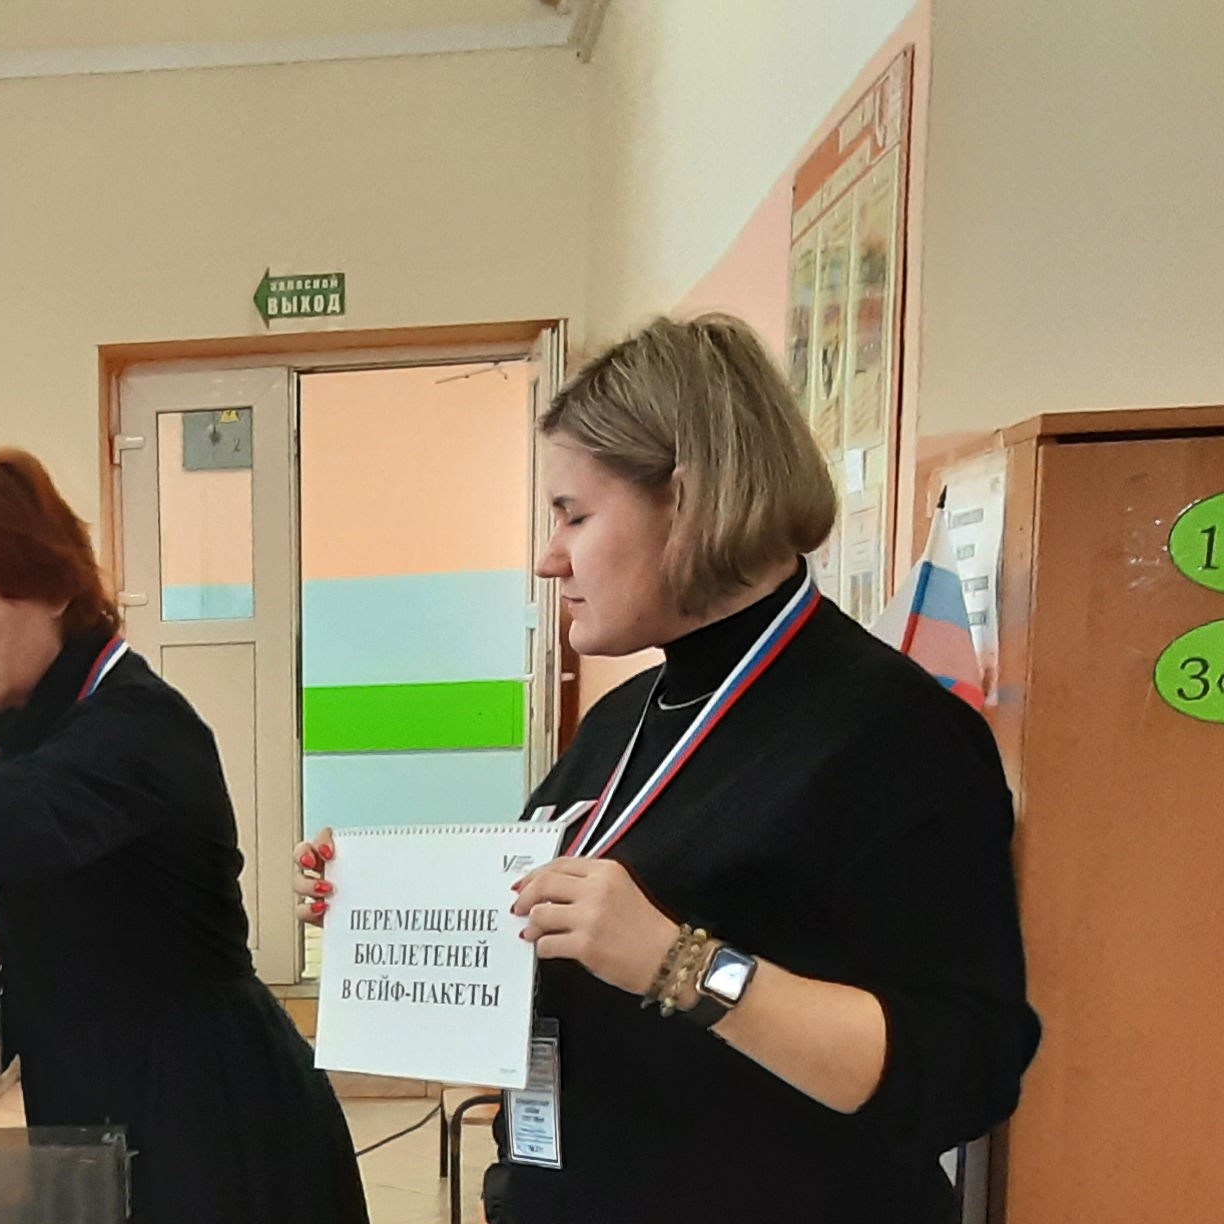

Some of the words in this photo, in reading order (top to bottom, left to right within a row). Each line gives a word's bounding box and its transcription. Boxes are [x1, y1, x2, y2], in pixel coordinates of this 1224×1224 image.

[266, 292, 341, 315] ВЫХОД
[349, 908, 499, 933] ПЕРЕМЕЩЕНИЕ
[354, 940, 490, 968] БЮЛЛЕТЕНЕЙ
[341, 978, 352, 999] В
[355, 974, 502, 1007] СЕЙФ-ПАКЕТЫ
